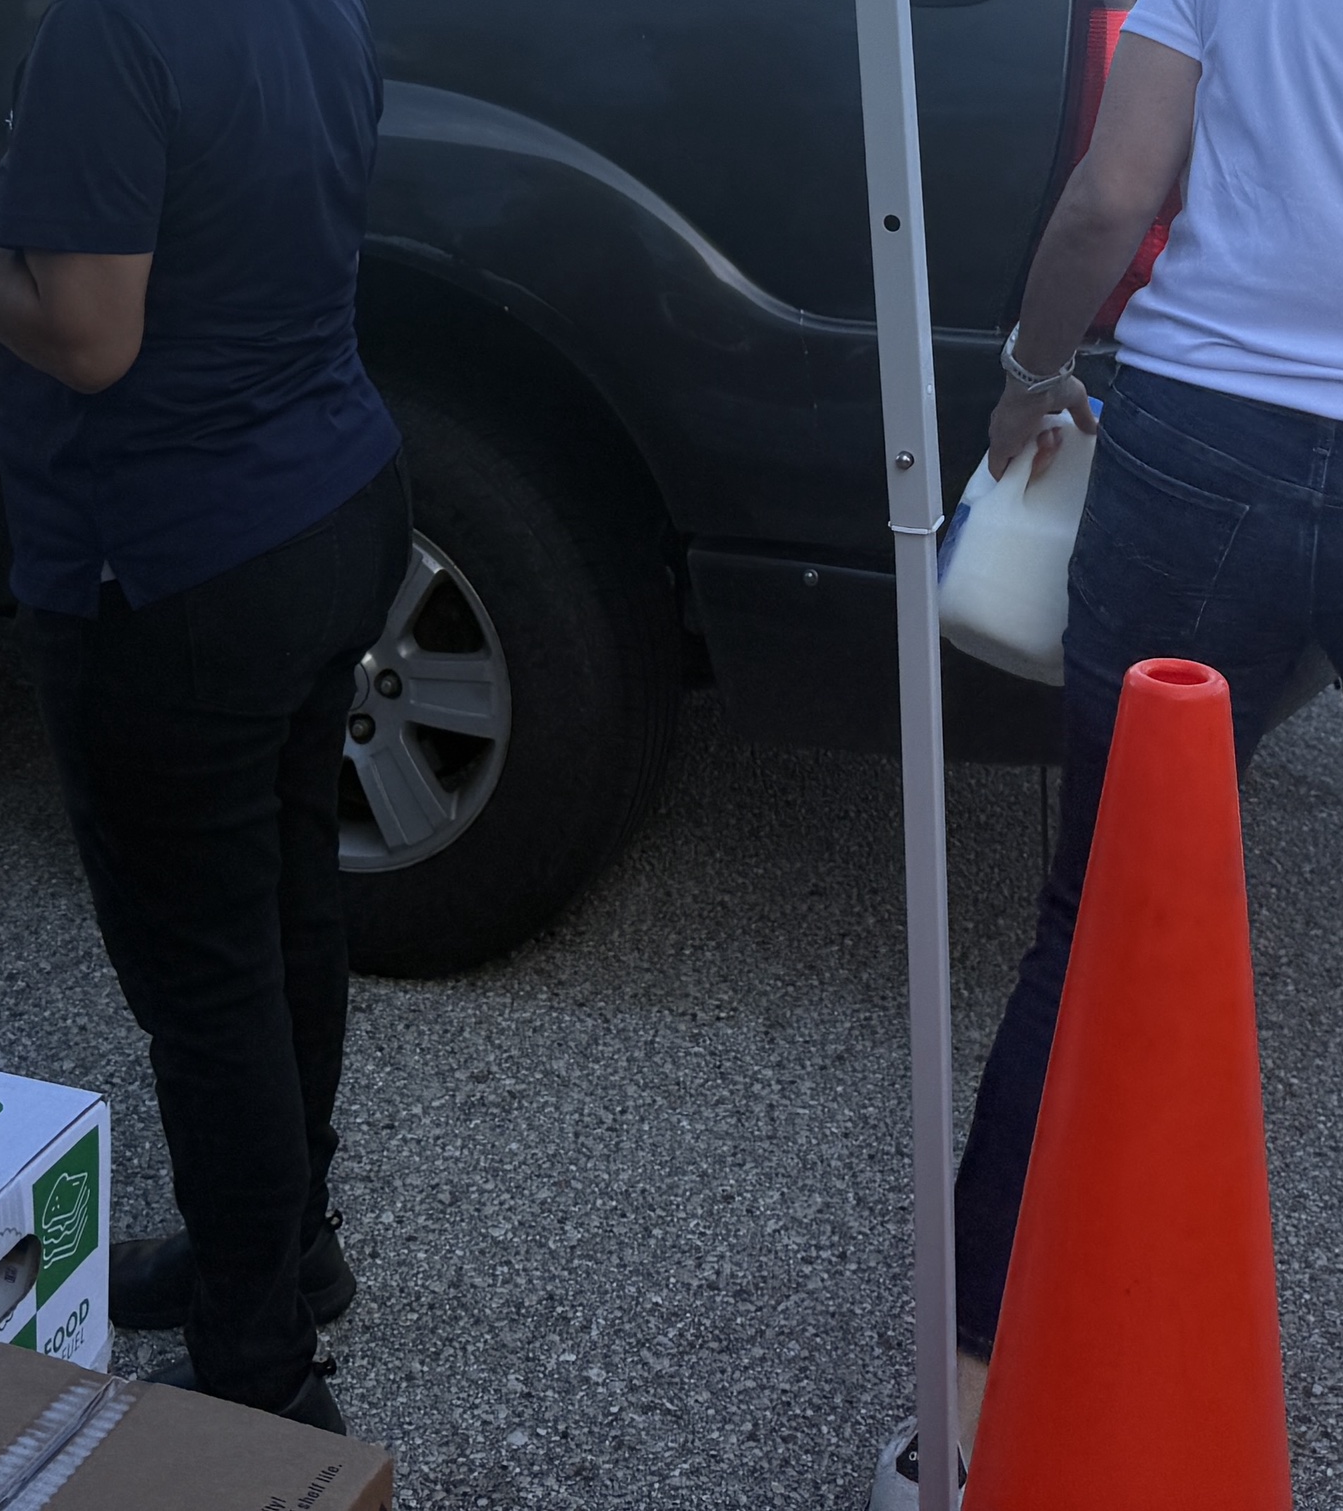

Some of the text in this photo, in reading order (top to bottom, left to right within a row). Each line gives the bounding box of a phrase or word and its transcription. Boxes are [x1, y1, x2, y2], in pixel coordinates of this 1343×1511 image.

[44, 1298, 89, 1355] FOOD
[298, 1464, 343, 1510] shelf life.
